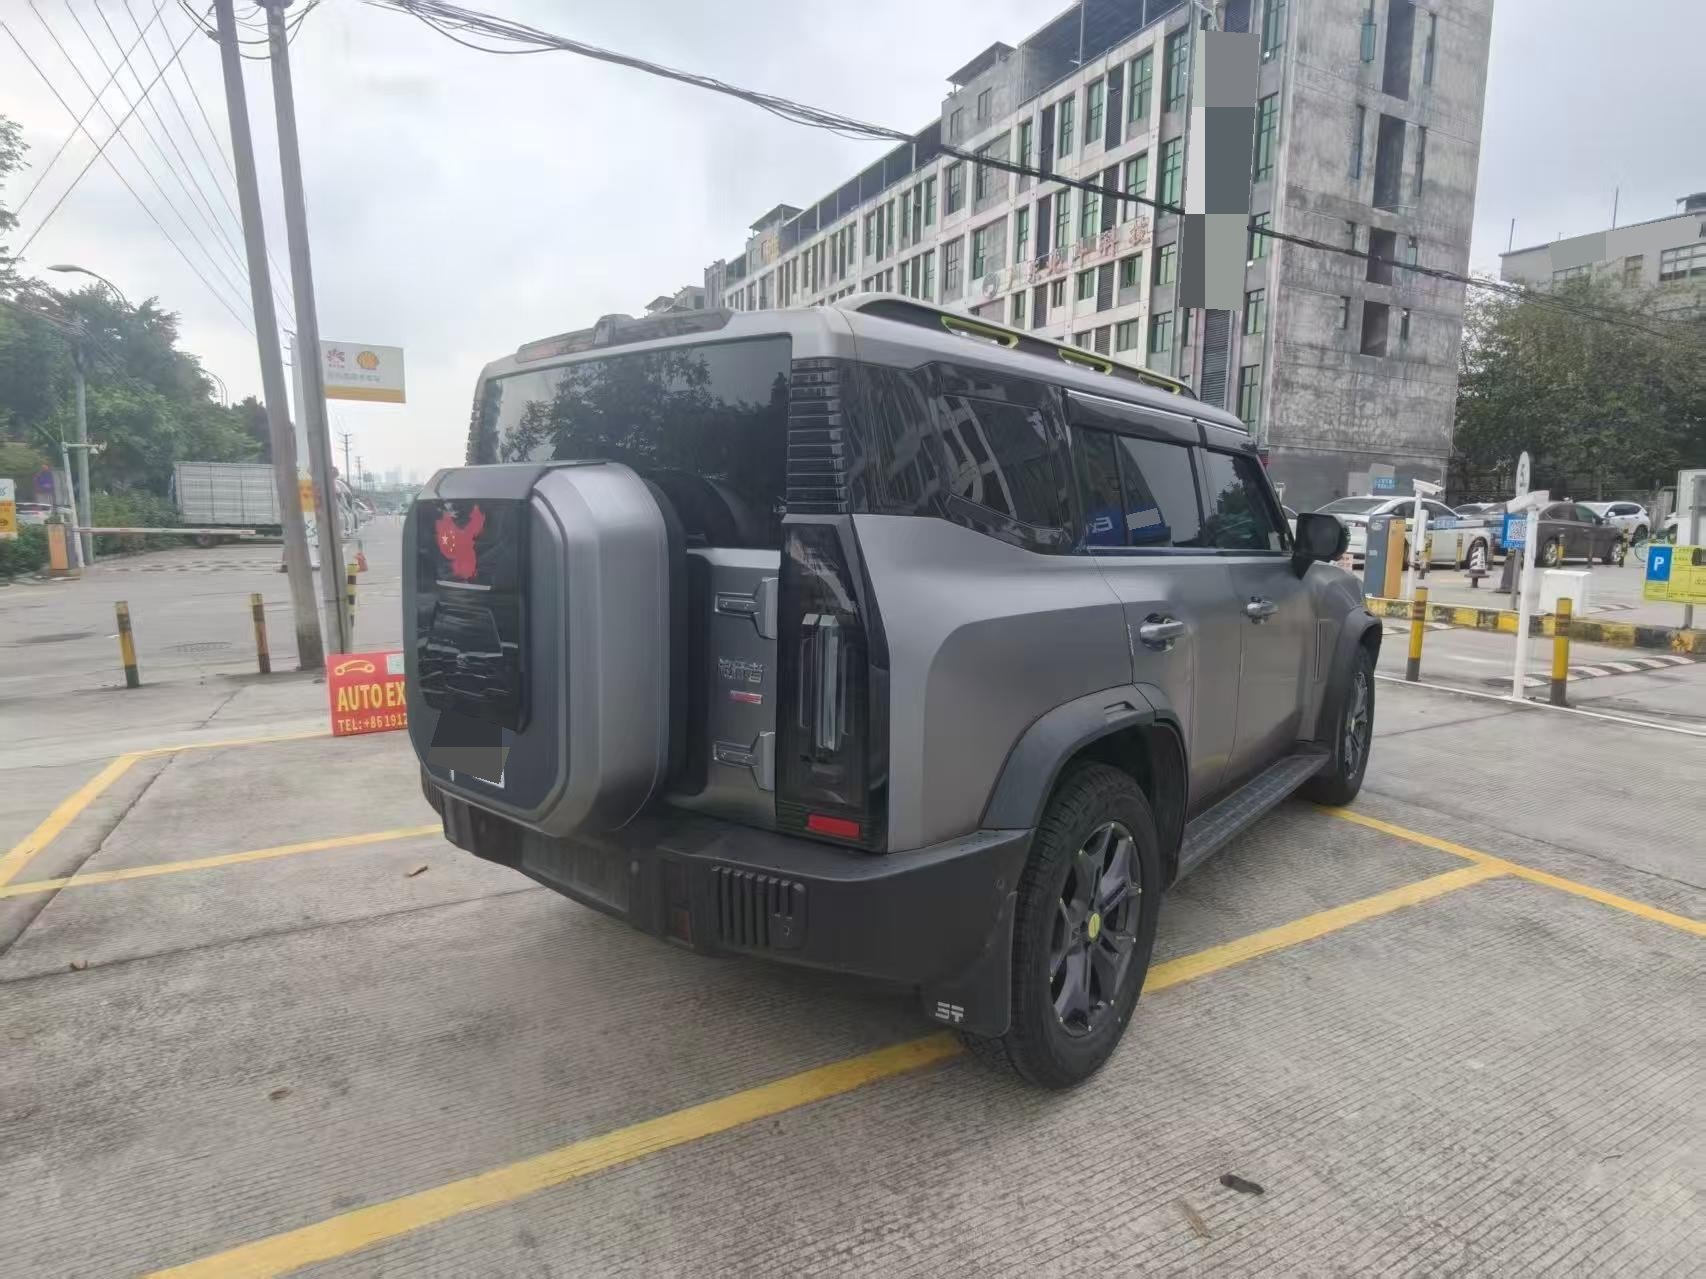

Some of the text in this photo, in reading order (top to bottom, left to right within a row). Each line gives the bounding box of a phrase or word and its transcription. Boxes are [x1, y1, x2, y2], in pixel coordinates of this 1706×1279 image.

[1654, 556, 1665, 571] P
[337, 681, 406, 711] AUTO EX
